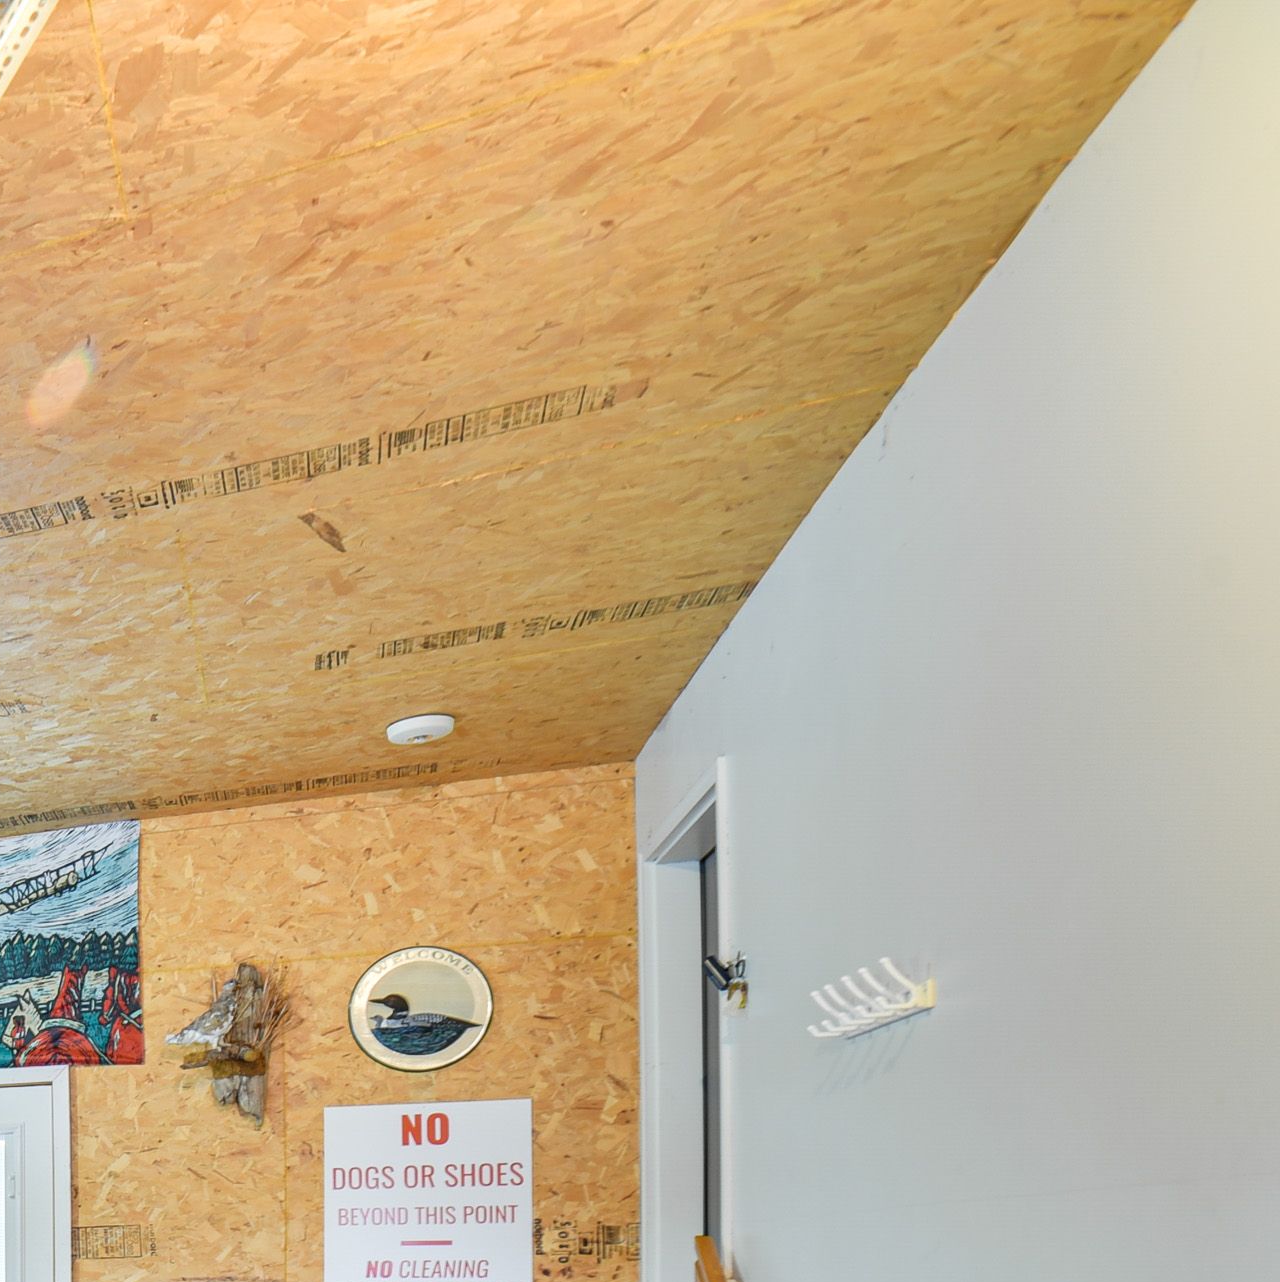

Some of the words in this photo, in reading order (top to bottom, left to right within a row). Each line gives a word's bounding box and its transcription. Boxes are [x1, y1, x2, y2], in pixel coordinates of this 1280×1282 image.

[369, 949, 476, 976] WELCOME
[401, 1112, 450, 1146] NO
[332, 1166, 395, 1190] DOGS
[403, 1164, 435, 1189] OR
[444, 1162, 524, 1188] SHOES
[338, 1206, 409, 1226] BEYOND
[414, 1205, 456, 1225] THIS
[463, 1204, 519, 1224] POINT
[365, 1260, 393, 1279] NO
[398, 1259, 489, 1279] CLEANING
